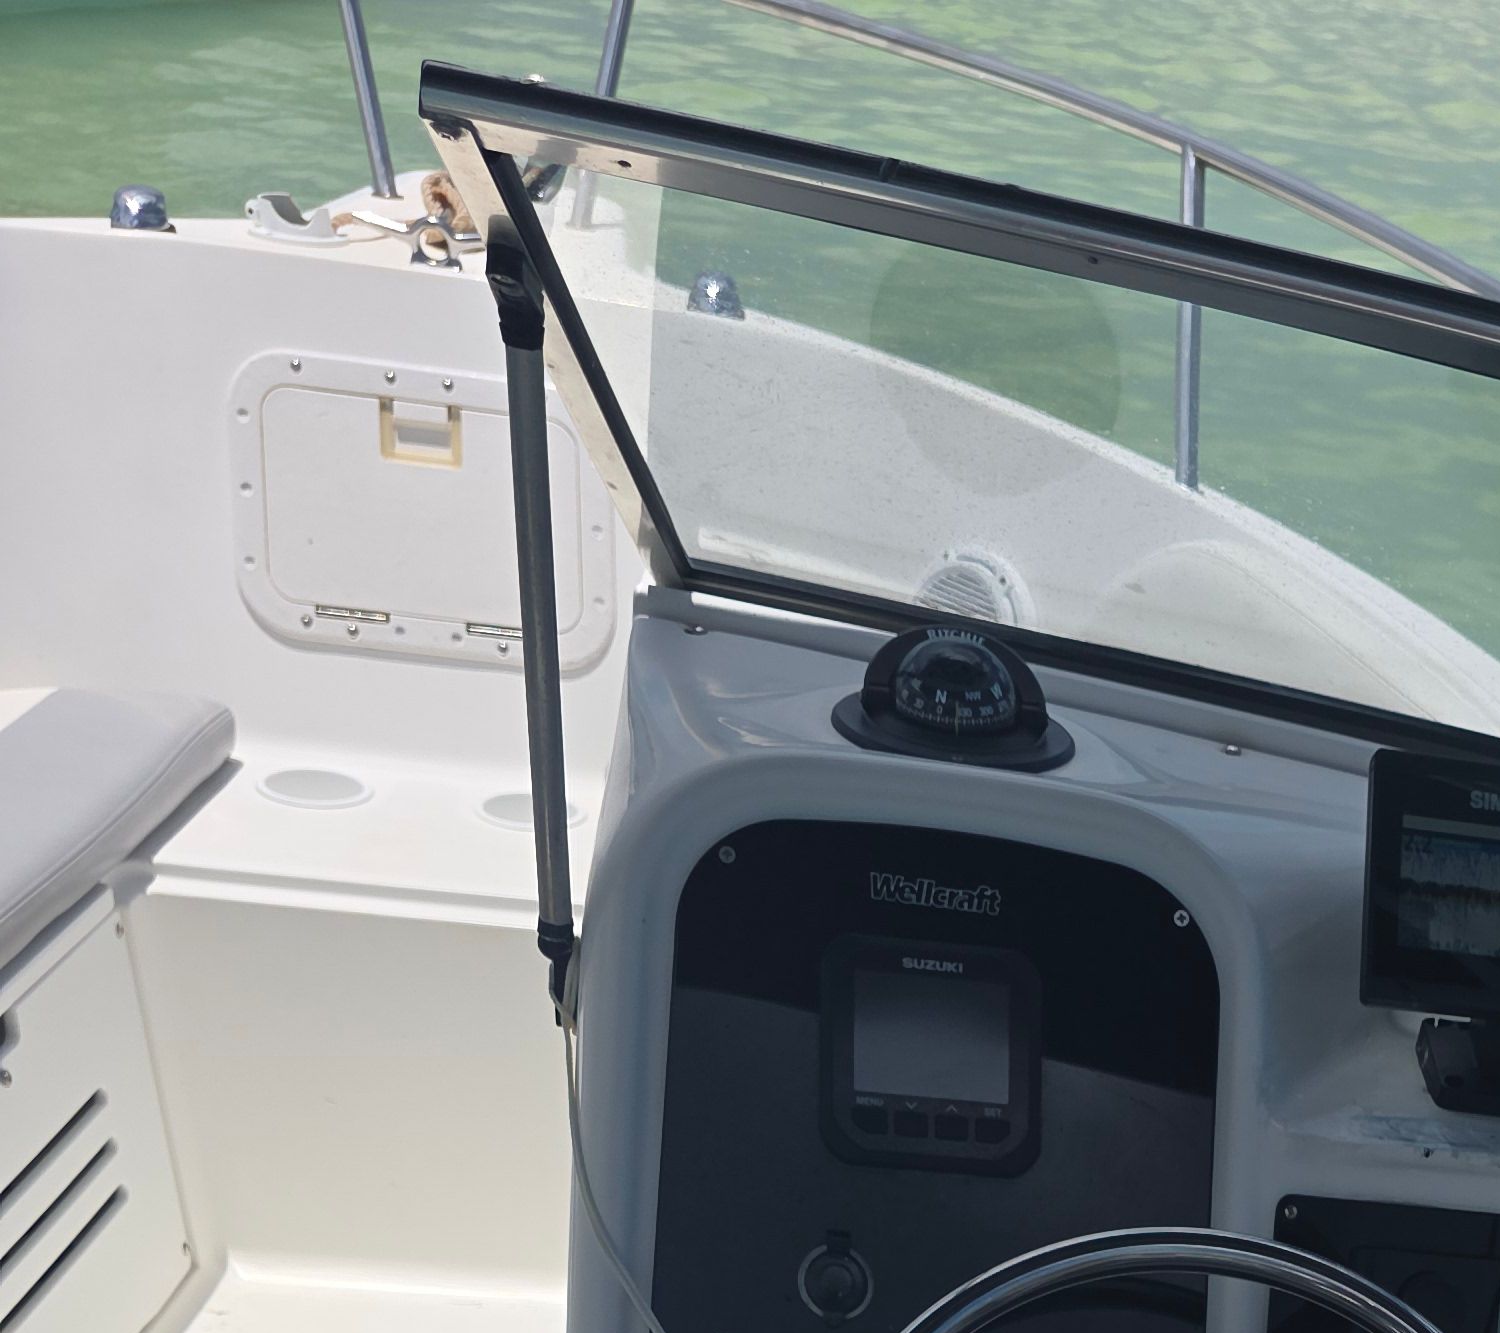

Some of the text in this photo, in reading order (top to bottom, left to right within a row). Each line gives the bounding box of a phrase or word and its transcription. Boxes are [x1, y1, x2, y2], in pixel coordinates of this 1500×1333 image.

[935, 689, 947, 704] N
[990, 682, 1003, 700] W
[870, 871, 1001, 916] Wellcraft
[902, 956, 964, 974] SUZUKI
